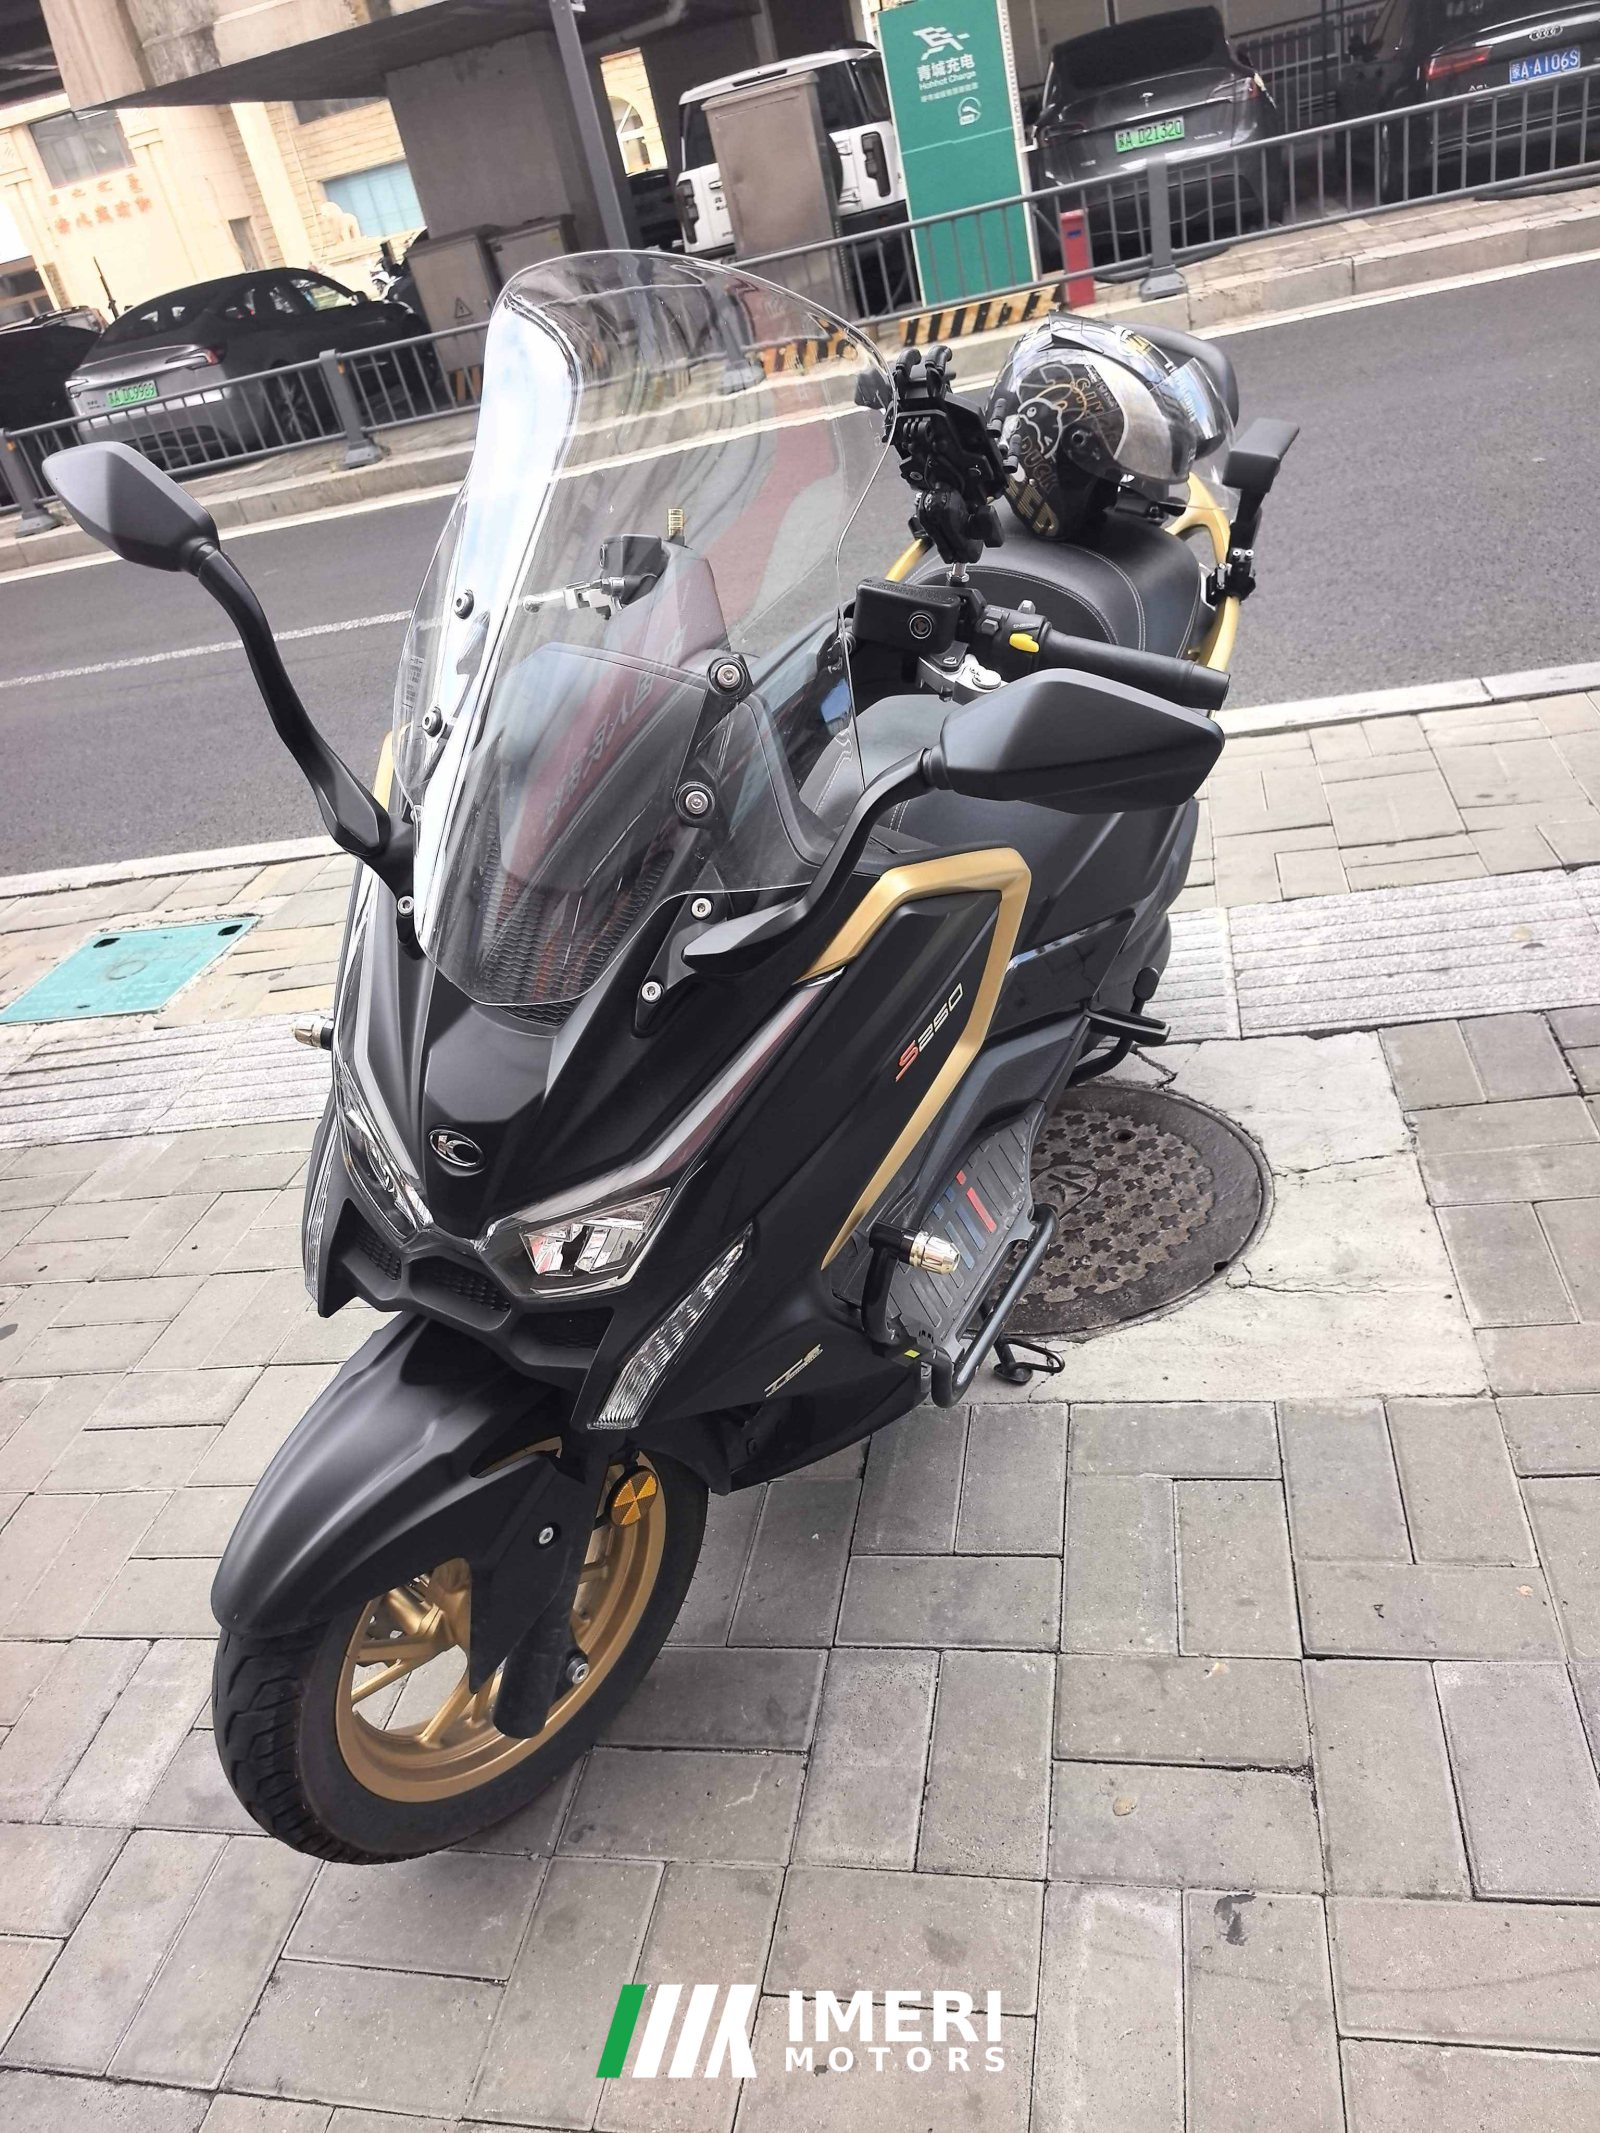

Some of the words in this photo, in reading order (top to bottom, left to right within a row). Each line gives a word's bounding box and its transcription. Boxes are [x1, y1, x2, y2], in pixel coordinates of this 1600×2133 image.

[916, 53, 975, 81] 青城充电
[918, 77, 948, 90] Hohhot
[948, 71, 977, 83] Charge
